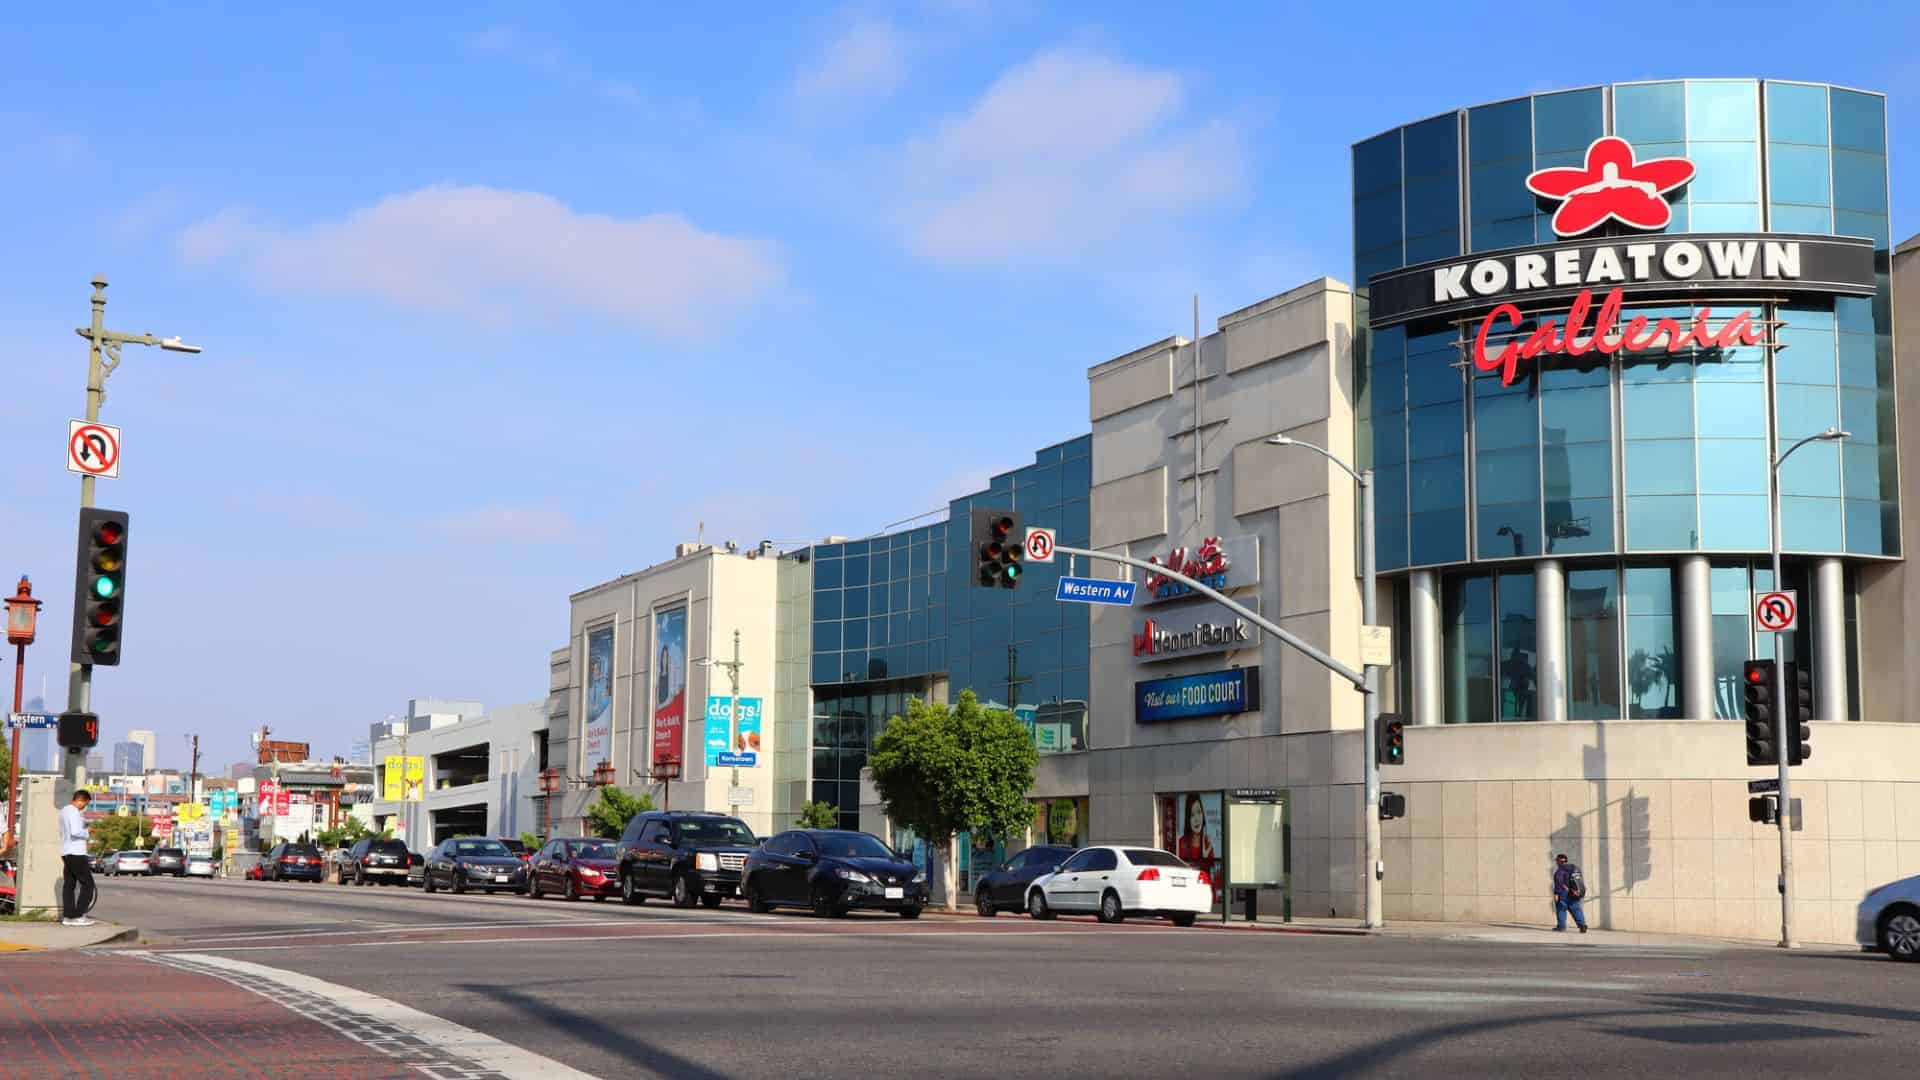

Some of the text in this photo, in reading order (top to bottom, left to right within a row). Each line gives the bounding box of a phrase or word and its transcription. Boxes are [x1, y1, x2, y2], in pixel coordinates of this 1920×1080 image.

[1434, 242, 1801, 302] KOREATOWN
[1474, 287, 1768, 388] Galleria
[1064, 582, 1129, 599] Western Av
[1182, 685, 1207, 706] FOOD
[1208, 680, 1241, 703] COURT
[10, 714, 46, 724] Western
[86, 719, 97, 741] 4
